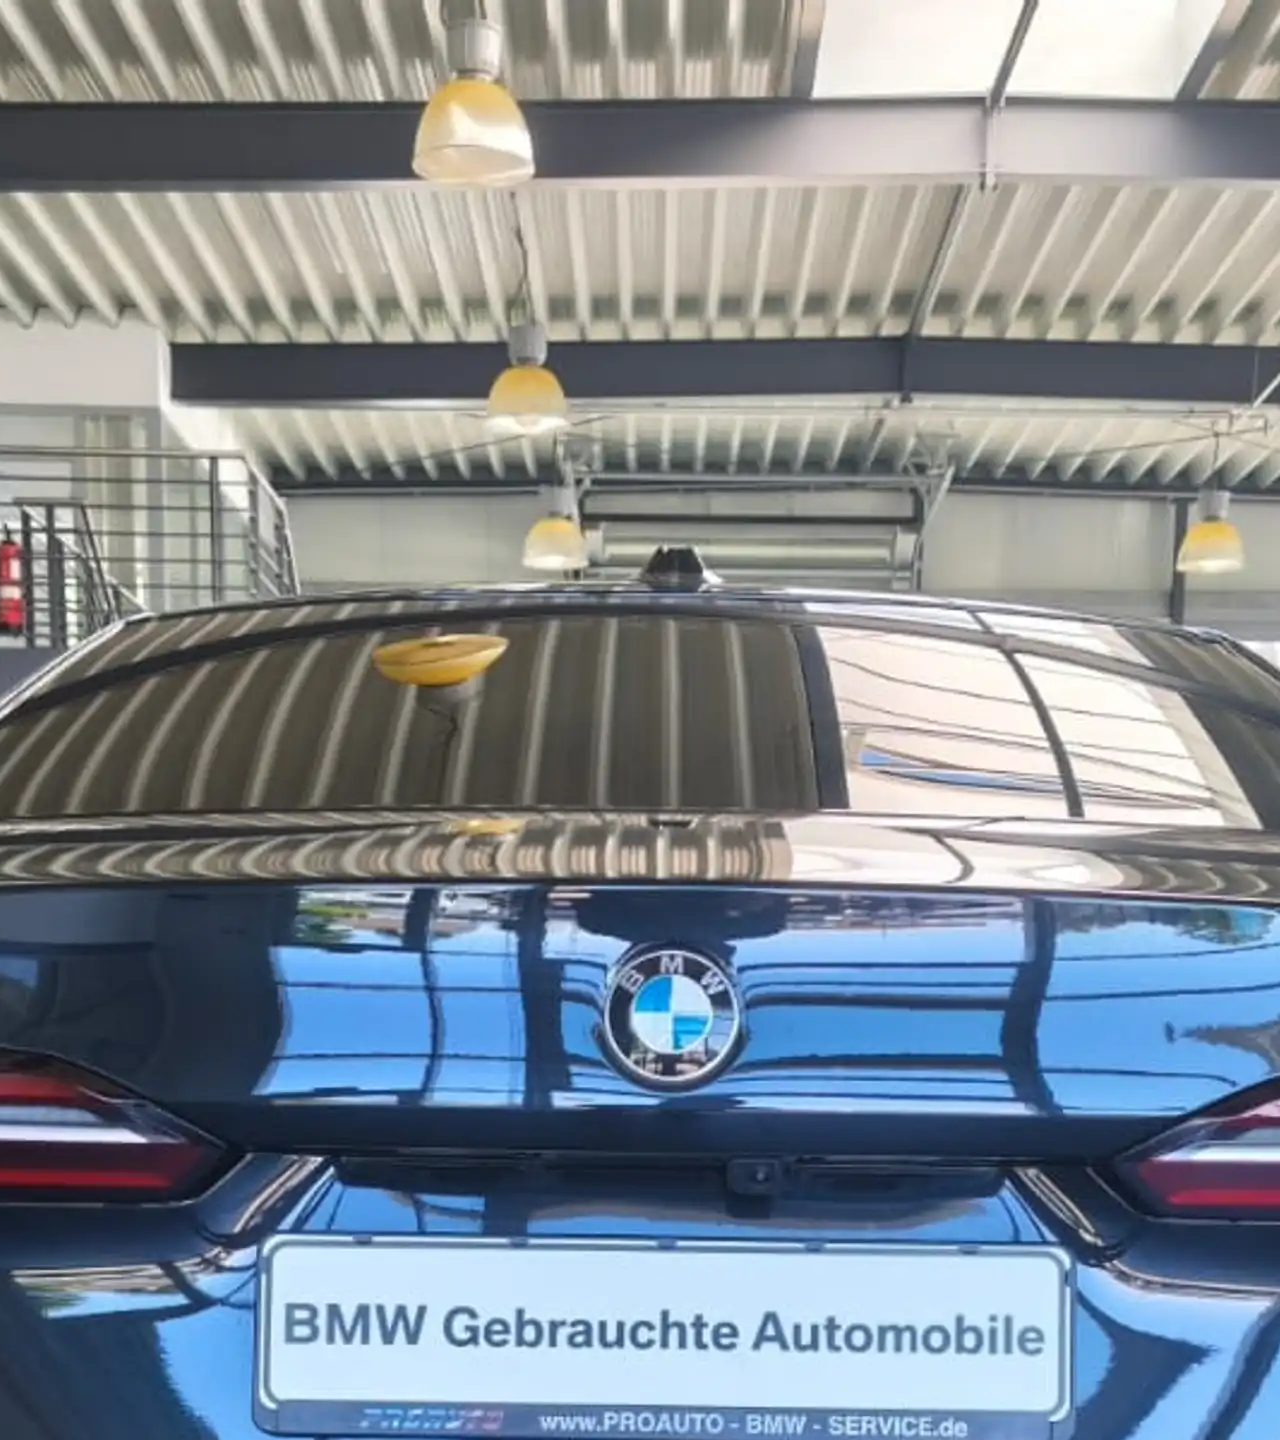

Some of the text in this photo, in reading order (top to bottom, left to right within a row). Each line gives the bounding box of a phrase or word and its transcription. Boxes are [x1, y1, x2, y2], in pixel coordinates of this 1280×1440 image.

[284, 1302, 1045, 1355] BMW Gebrauchte Automobile
[538, 1411, 725, 1434] www.PROAUTO
[745, 1413, 808, 1435] BMW
[827, 1415, 969, 1437] SERVICE.de
